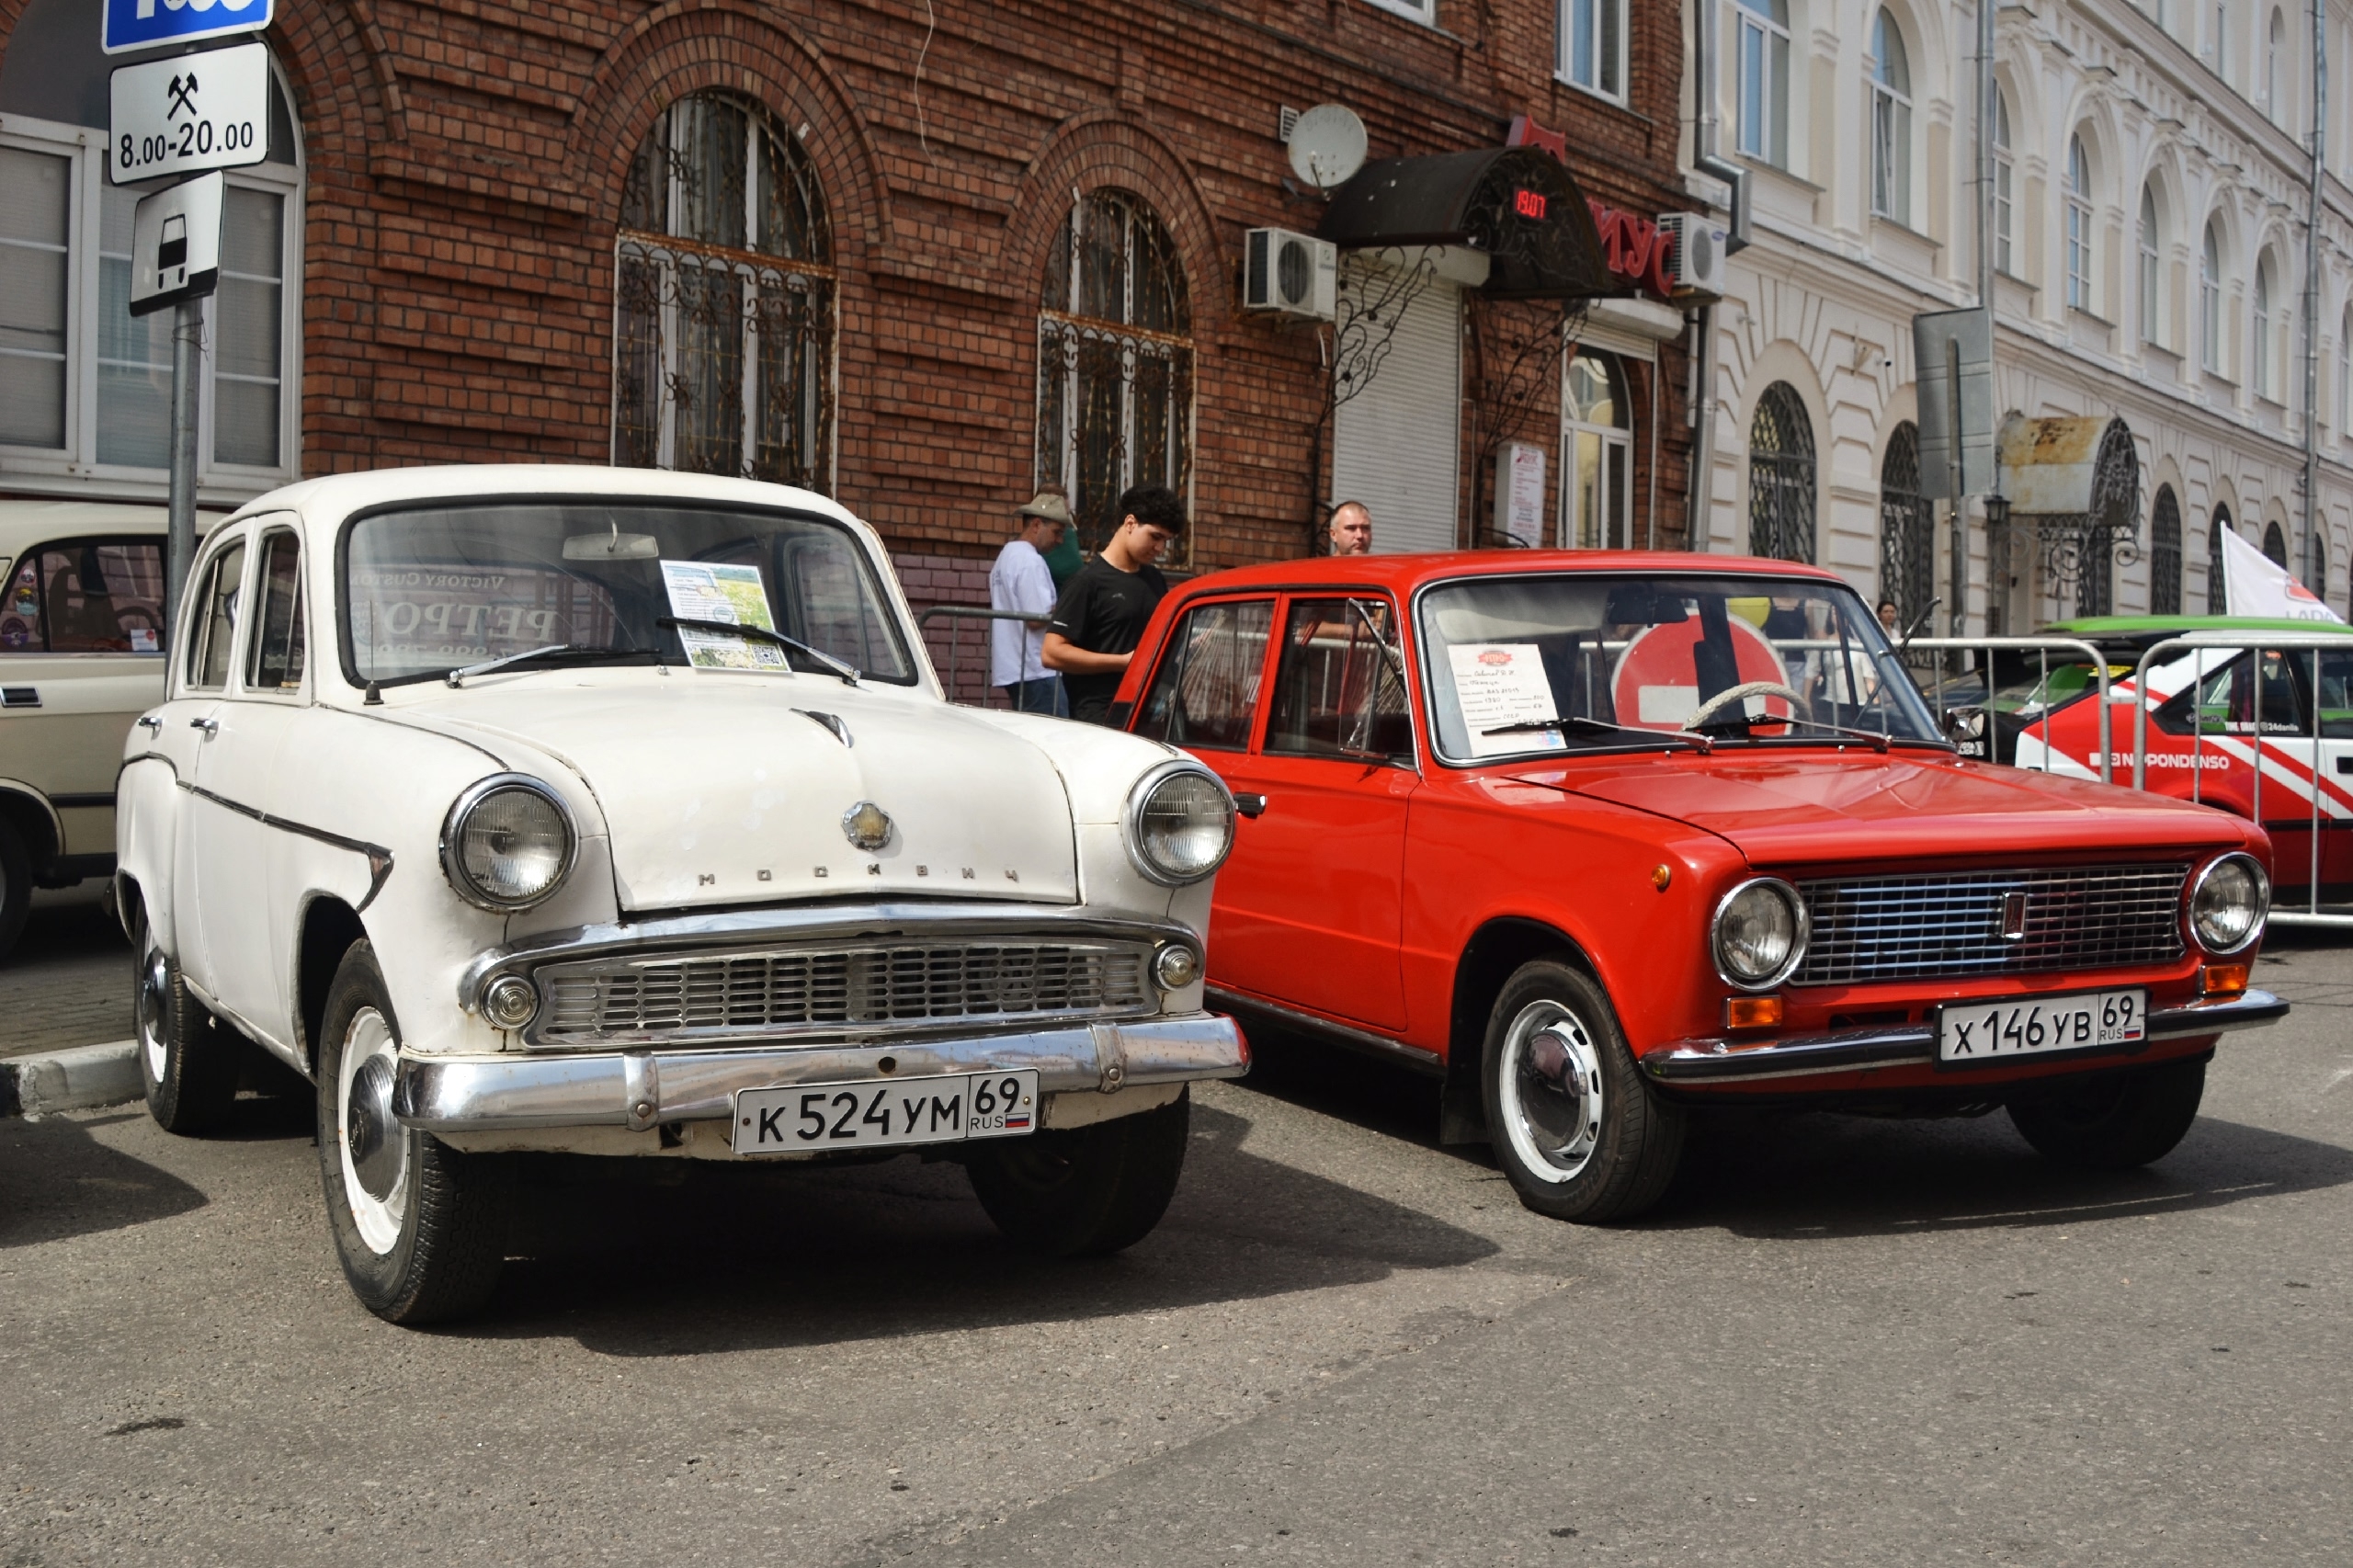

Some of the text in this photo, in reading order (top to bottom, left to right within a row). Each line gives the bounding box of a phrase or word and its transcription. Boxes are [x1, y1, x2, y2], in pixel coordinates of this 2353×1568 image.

[120, 120, 253, 168] 8.00-20.00
[2122, 753, 2230, 769] NPONDENSO
[1953, 994, 2134, 1054] Х146УВ 69
[2099, 1028, 2123, 1041] RUS
[758, 1077, 1020, 1143] К524УМ 69
[971, 1115, 1004, 1131] RUS
